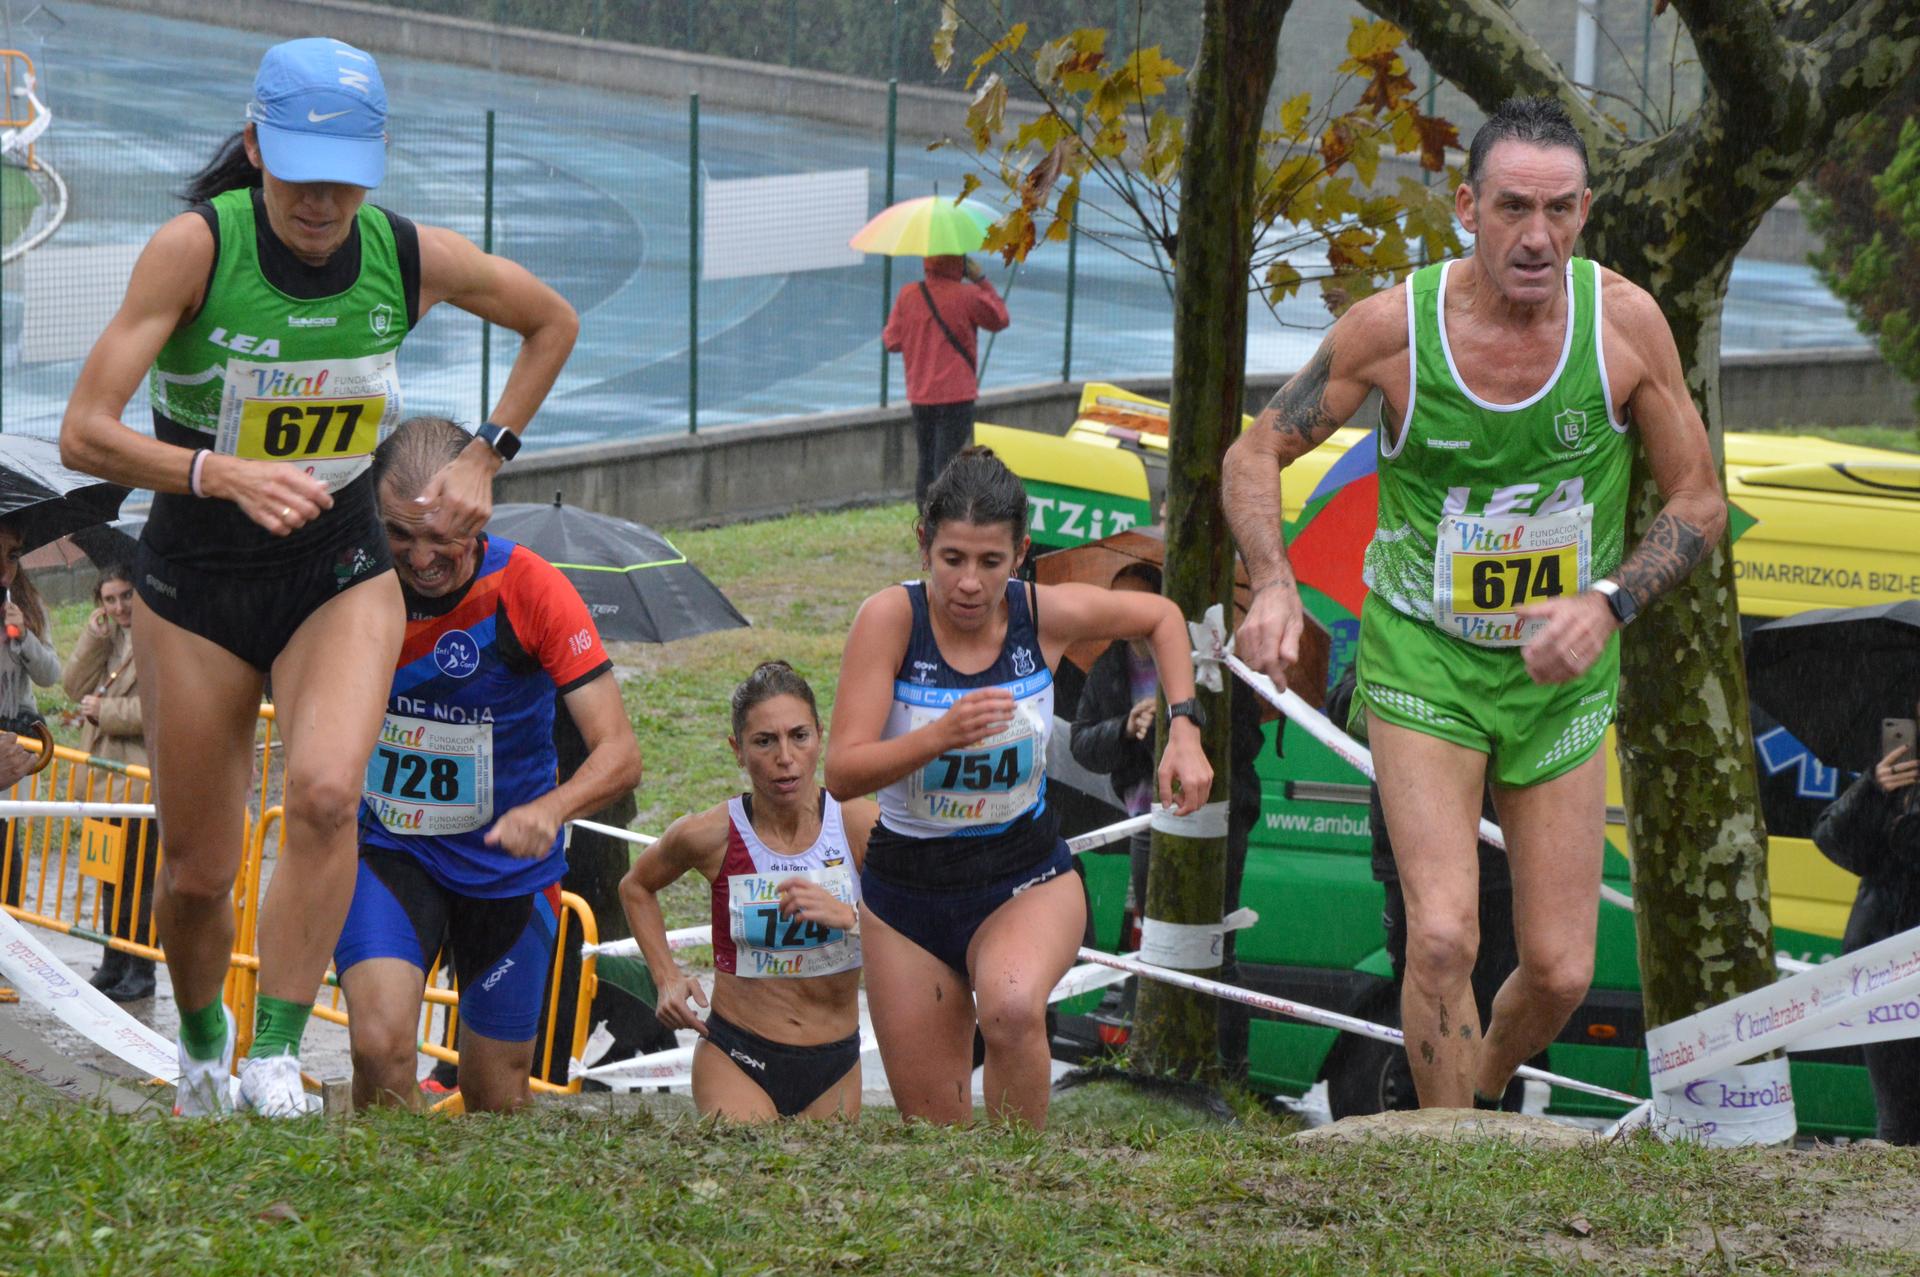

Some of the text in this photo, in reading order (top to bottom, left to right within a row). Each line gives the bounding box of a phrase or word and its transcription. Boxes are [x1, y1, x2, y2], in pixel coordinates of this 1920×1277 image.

[208, 327, 280, 358] LEA
[251, 368, 330, 397] Vital
[264, 403, 365, 457] 677
[1441, 475, 1585, 518] LEA
[1454, 524, 1525, 551] Vital
[1472, 554, 1564, 610] 674
[1732, 560, 1863, 589] OINARRIZKOA
[1454, 615, 1525, 642] Vital
[433, 702, 495, 724] NOJA
[378, 747, 460, 803] 728
[938, 746, 1021, 791] 754
[367, 795, 425, 830] Vital
[924, 794, 987, 819] Vital
[770, 864, 808, 873] de la Torre
[757, 908, 831, 948] 724
[751, 950, 804, 976] Vital
[1748, 1000, 1806, 1040] kirolaraba
[1866, 994, 1920, 1025] kiro
